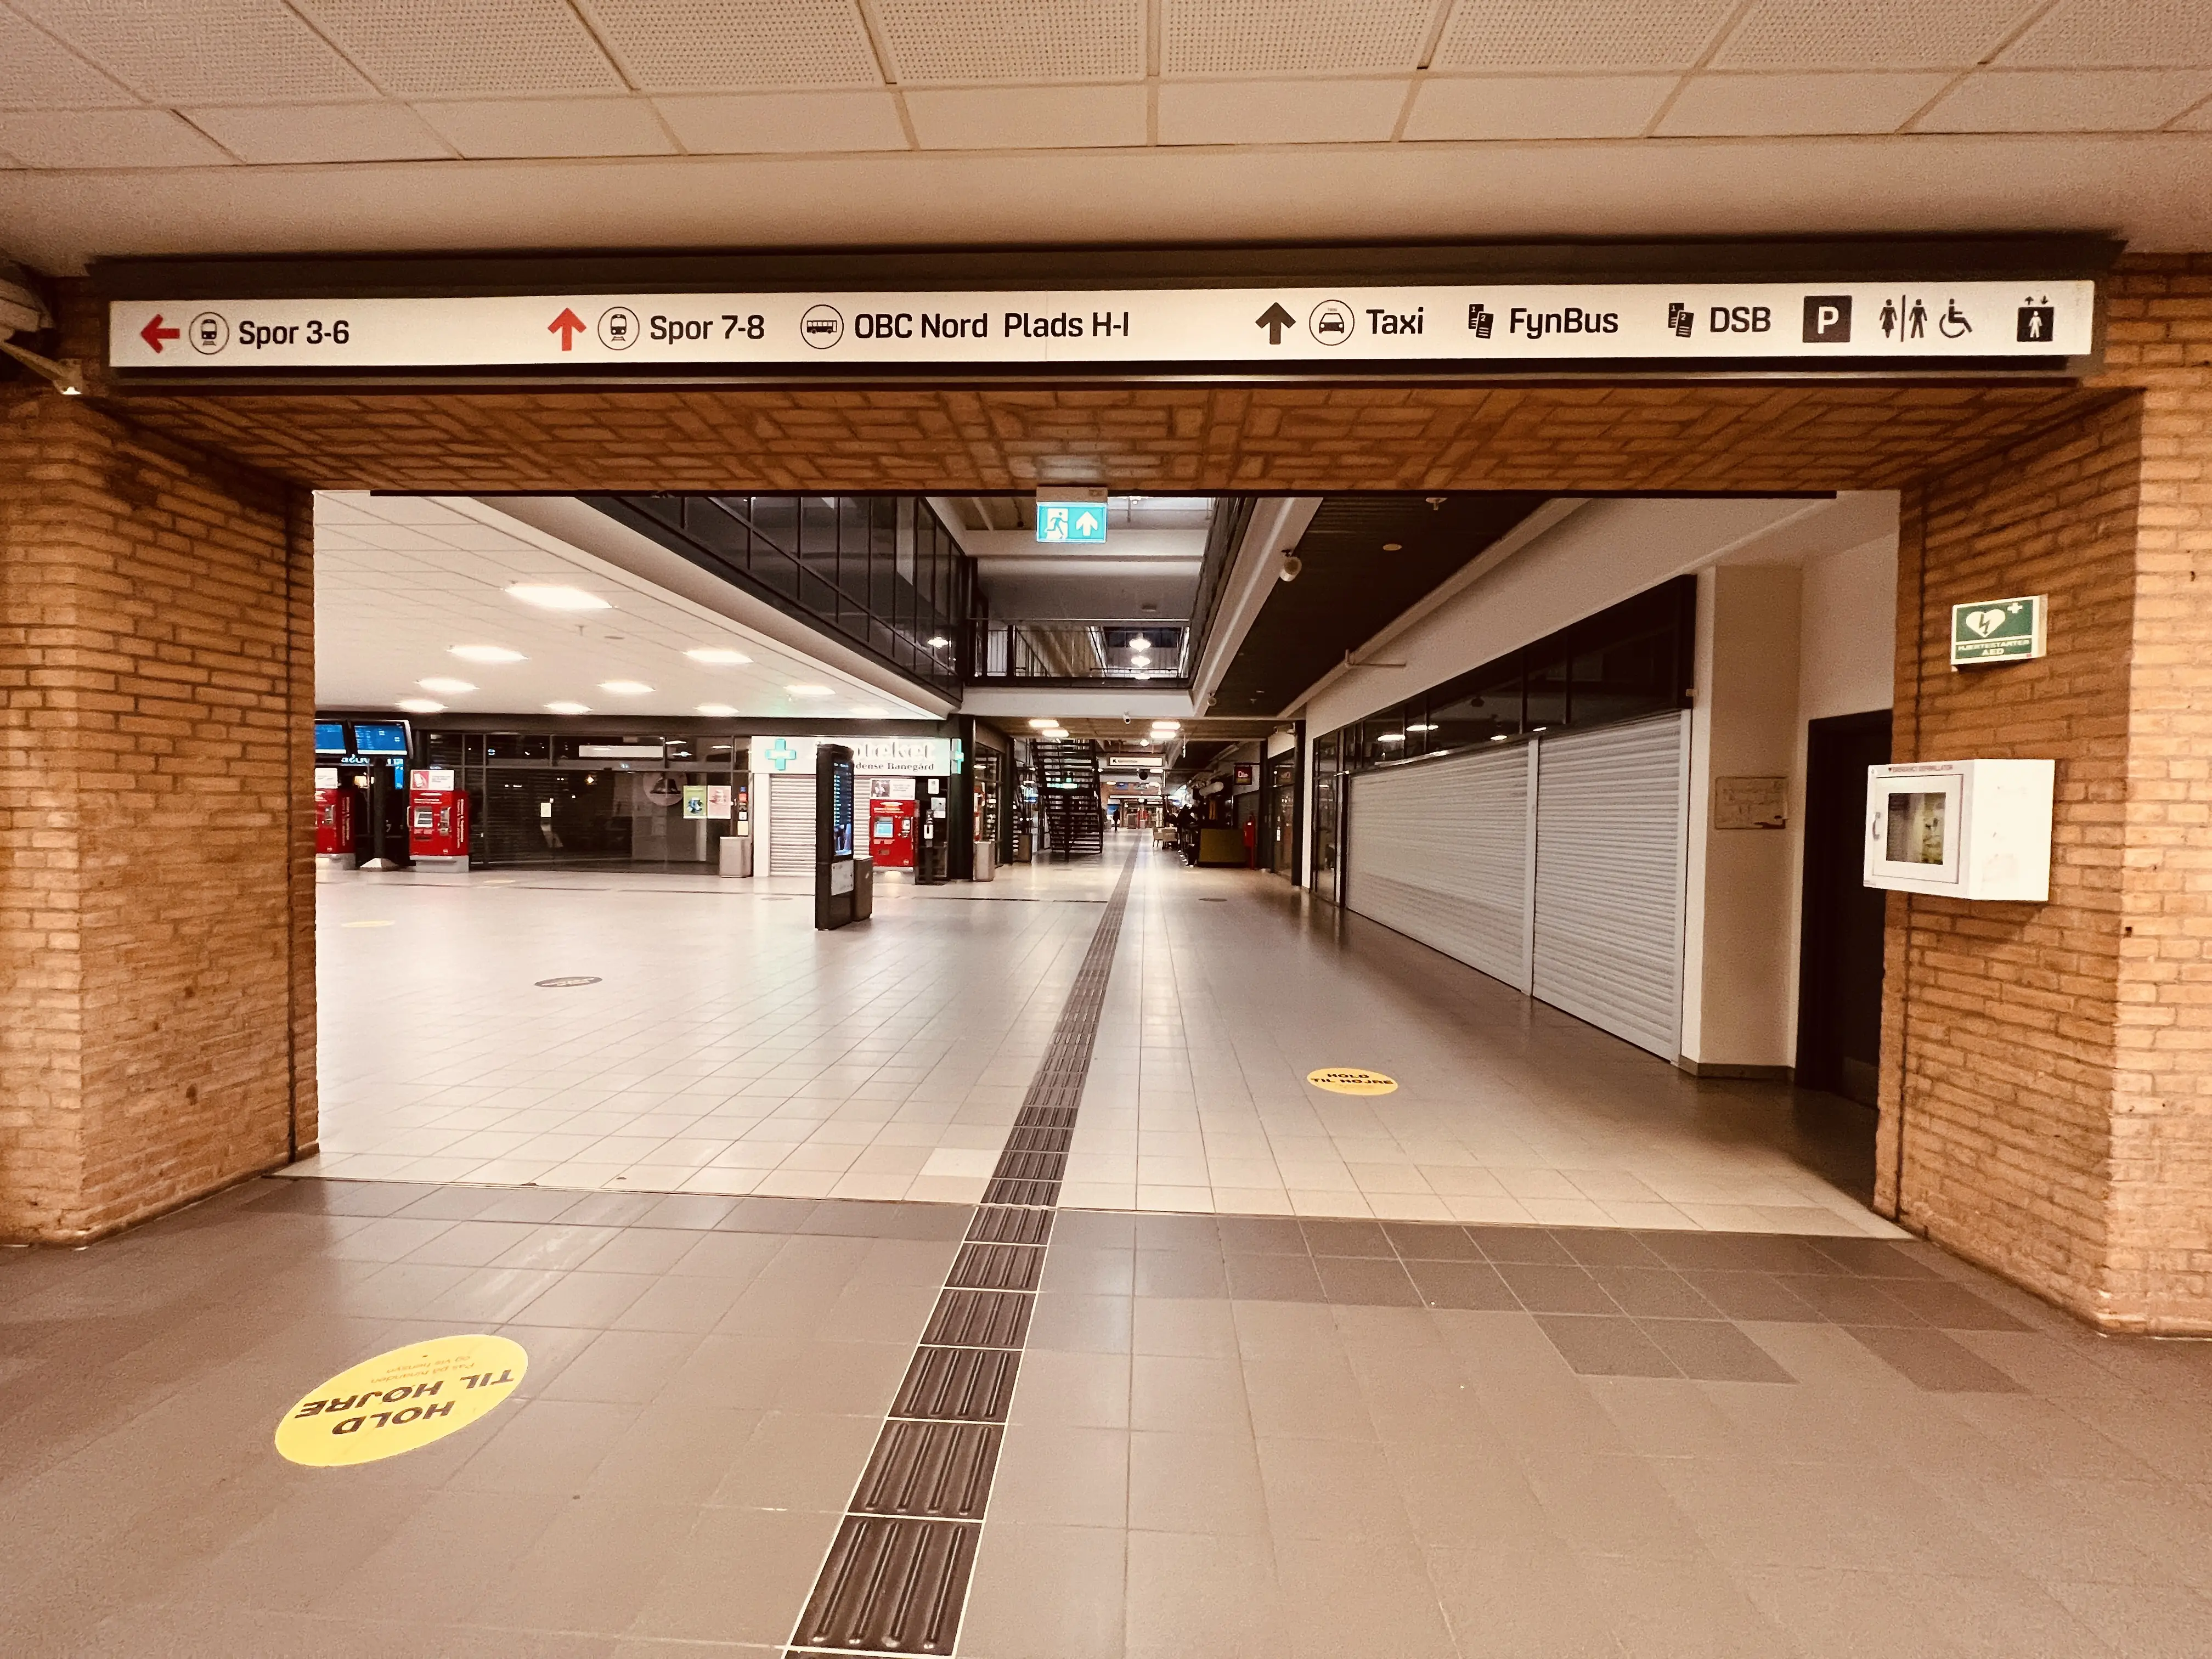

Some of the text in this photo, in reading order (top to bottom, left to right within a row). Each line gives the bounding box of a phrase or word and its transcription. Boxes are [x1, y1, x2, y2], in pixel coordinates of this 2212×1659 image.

[650, 314, 765, 345] Spor 7-8
[855, 313, 912, 338] OBC
[921, 313, 988, 338] Nord
[1005, 312, 1083, 337] Plads
[1365, 306, 1424, 335] Taxi
[1510, 307, 1618, 340] FynBus
[1710, 306, 1771, 333] DSB
[1818, 306, 1839, 335] P
[239, 320, 349, 349] Spor 3-6
[1982, 647, 2005, 656] AED
[853, 741, 936, 762] oteket
[854, 761, 883, 770] dense
[295, 1370, 515, 1419] TIL HØJRE
[332, 1400, 456, 1435] HOLD
